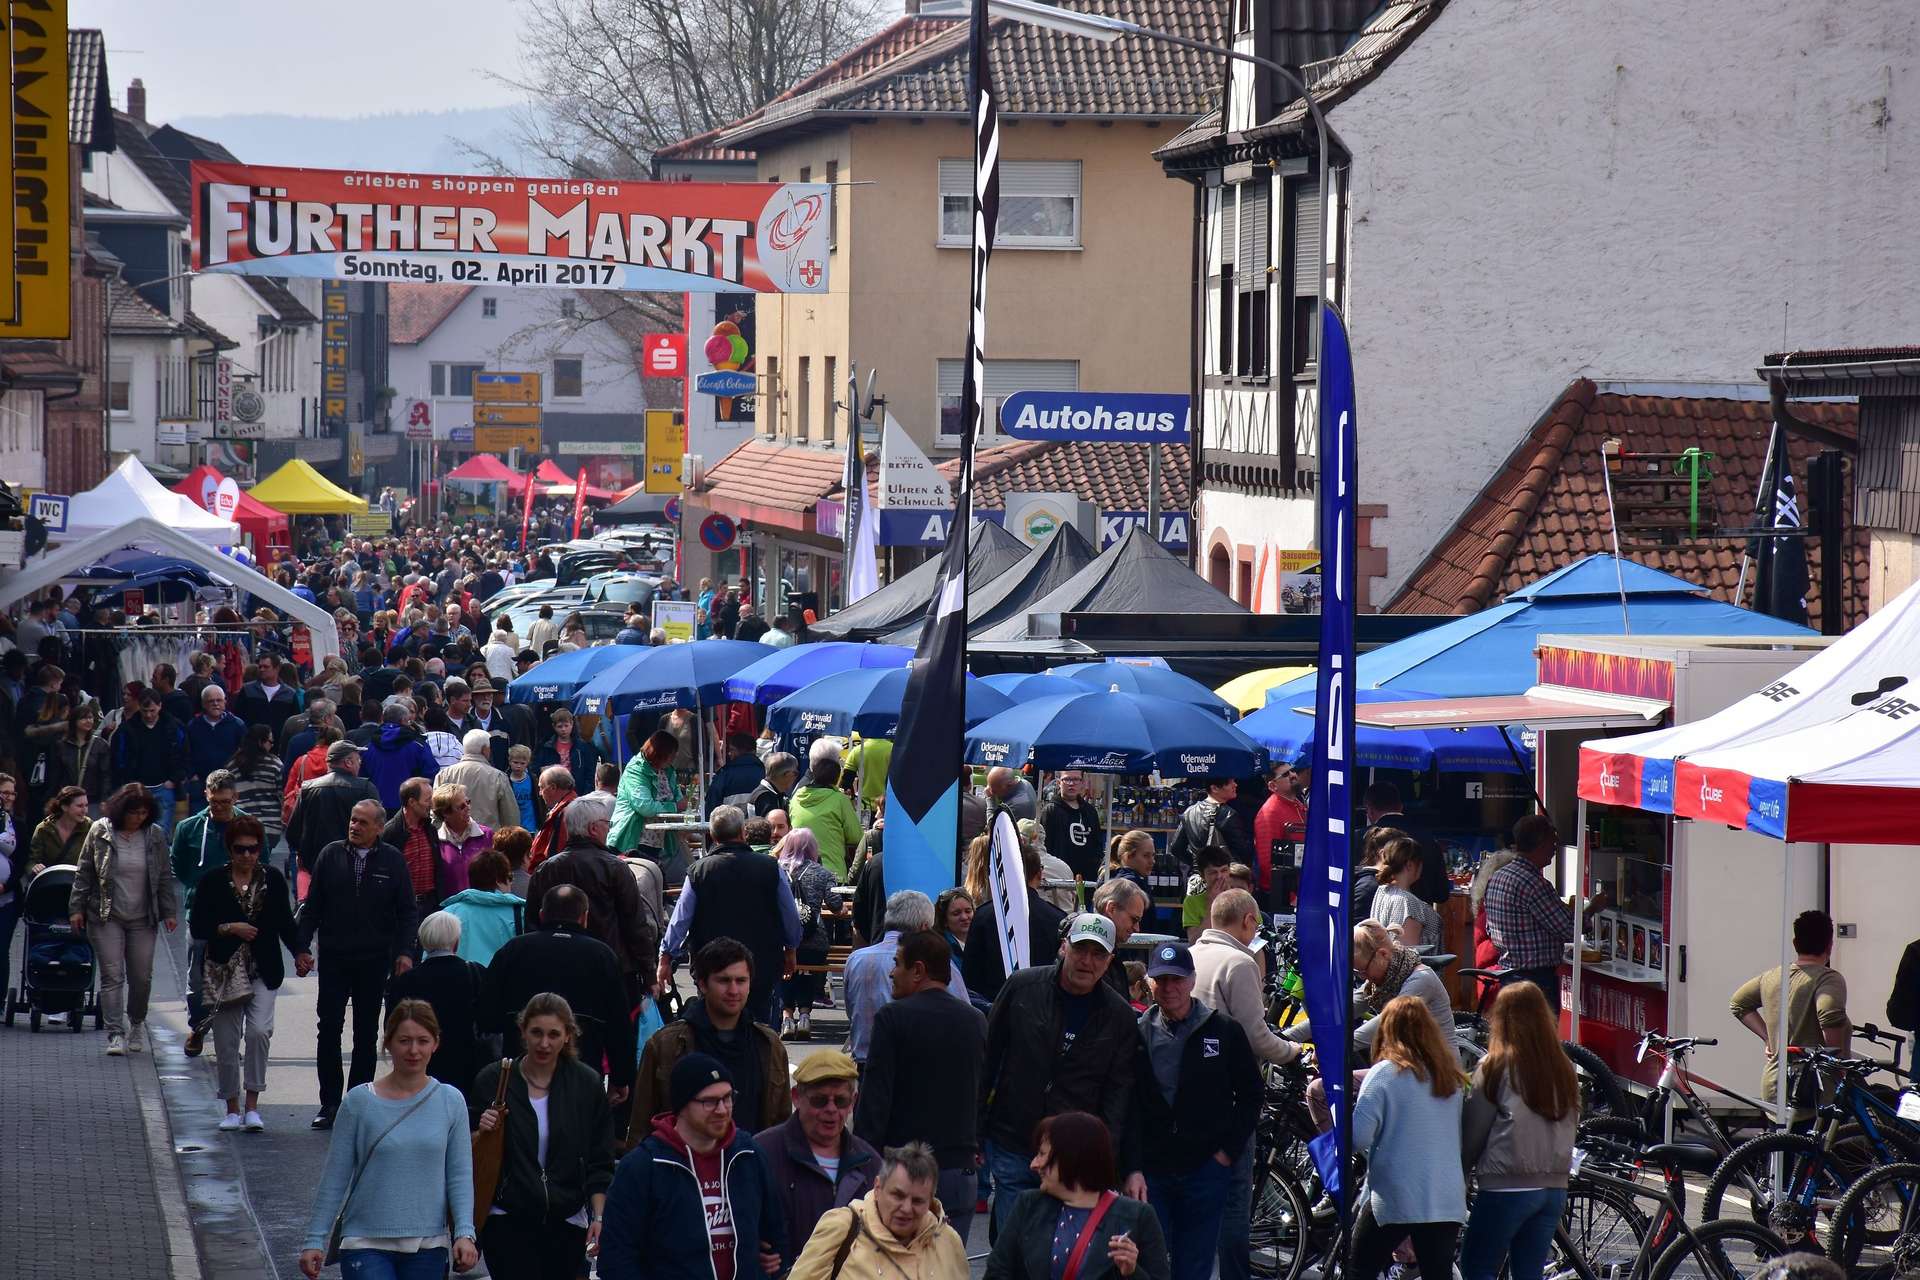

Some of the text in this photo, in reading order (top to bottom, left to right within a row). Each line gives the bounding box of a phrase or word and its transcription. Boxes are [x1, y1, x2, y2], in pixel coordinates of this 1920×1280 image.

[343, 173, 619, 197] erleben shoppen genießen
[201, 182, 750, 283] FÜRTHER MARKT
[343, 255, 616, 285] Sonntag, 02. April 2017
[1014, 404, 1175, 432] Autohaus
[934, 485, 944, 494] &
[39, 501, 60, 517] WC
[533, 685, 558, 693] Odenwald
[800, 711, 832, 723] Odenwald
[804, 721, 826, 731] Quelle
[980, 742, 1009, 754] Odenwald
[985, 751, 1004, 762] Quelle
[1180, 753, 1216, 764] Odenwald
[1187, 763, 1209, 773] Quelle
[1081, 924, 1108, 938] DEKRA
